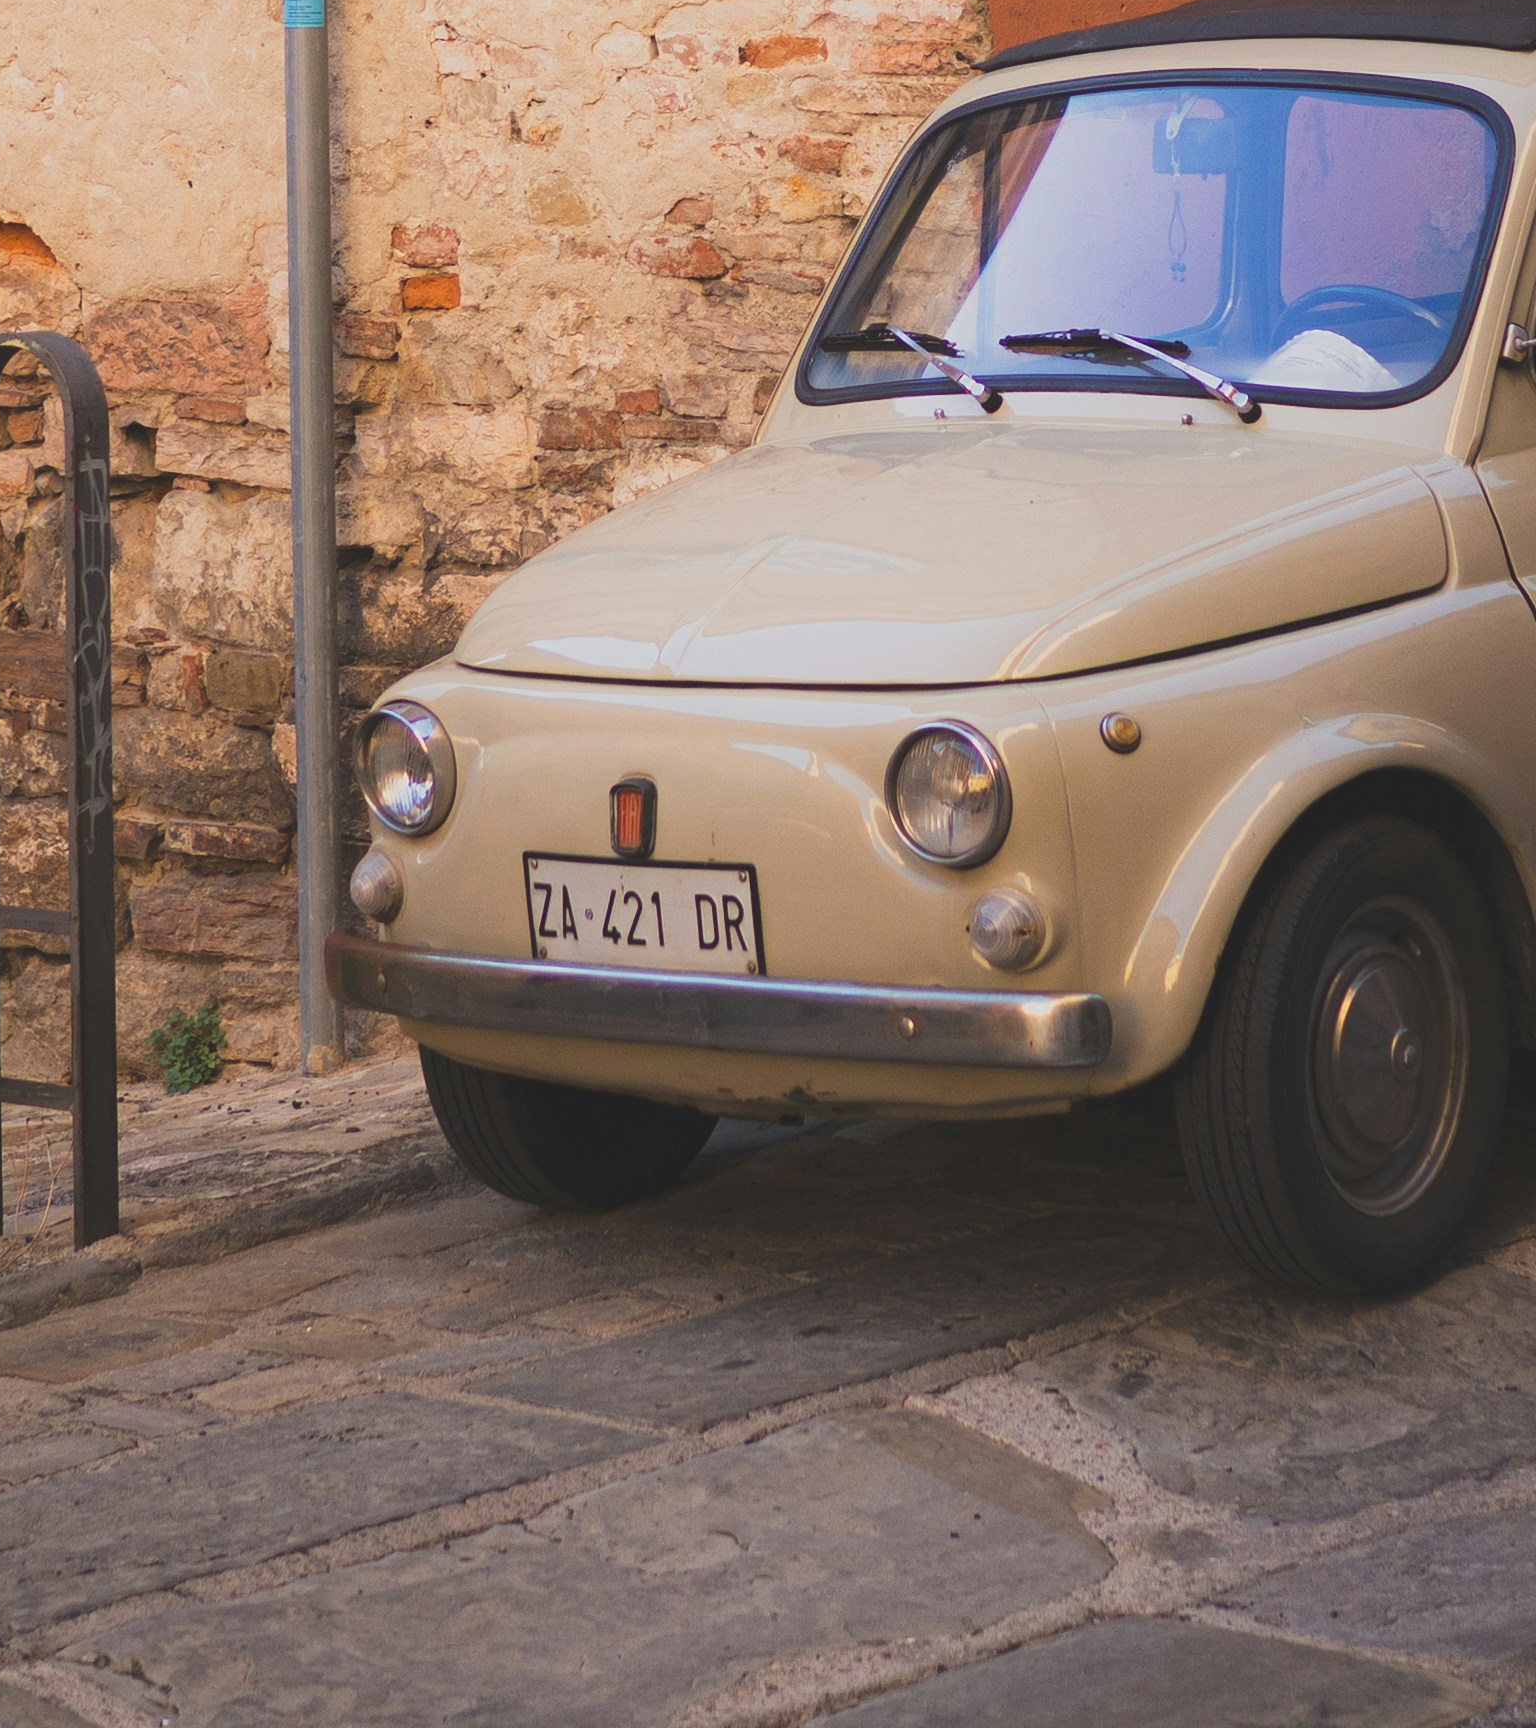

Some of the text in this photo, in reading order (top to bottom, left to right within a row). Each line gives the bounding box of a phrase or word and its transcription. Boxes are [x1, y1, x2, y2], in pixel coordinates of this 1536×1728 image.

[533, 882, 749, 952] ZA 421 DR
